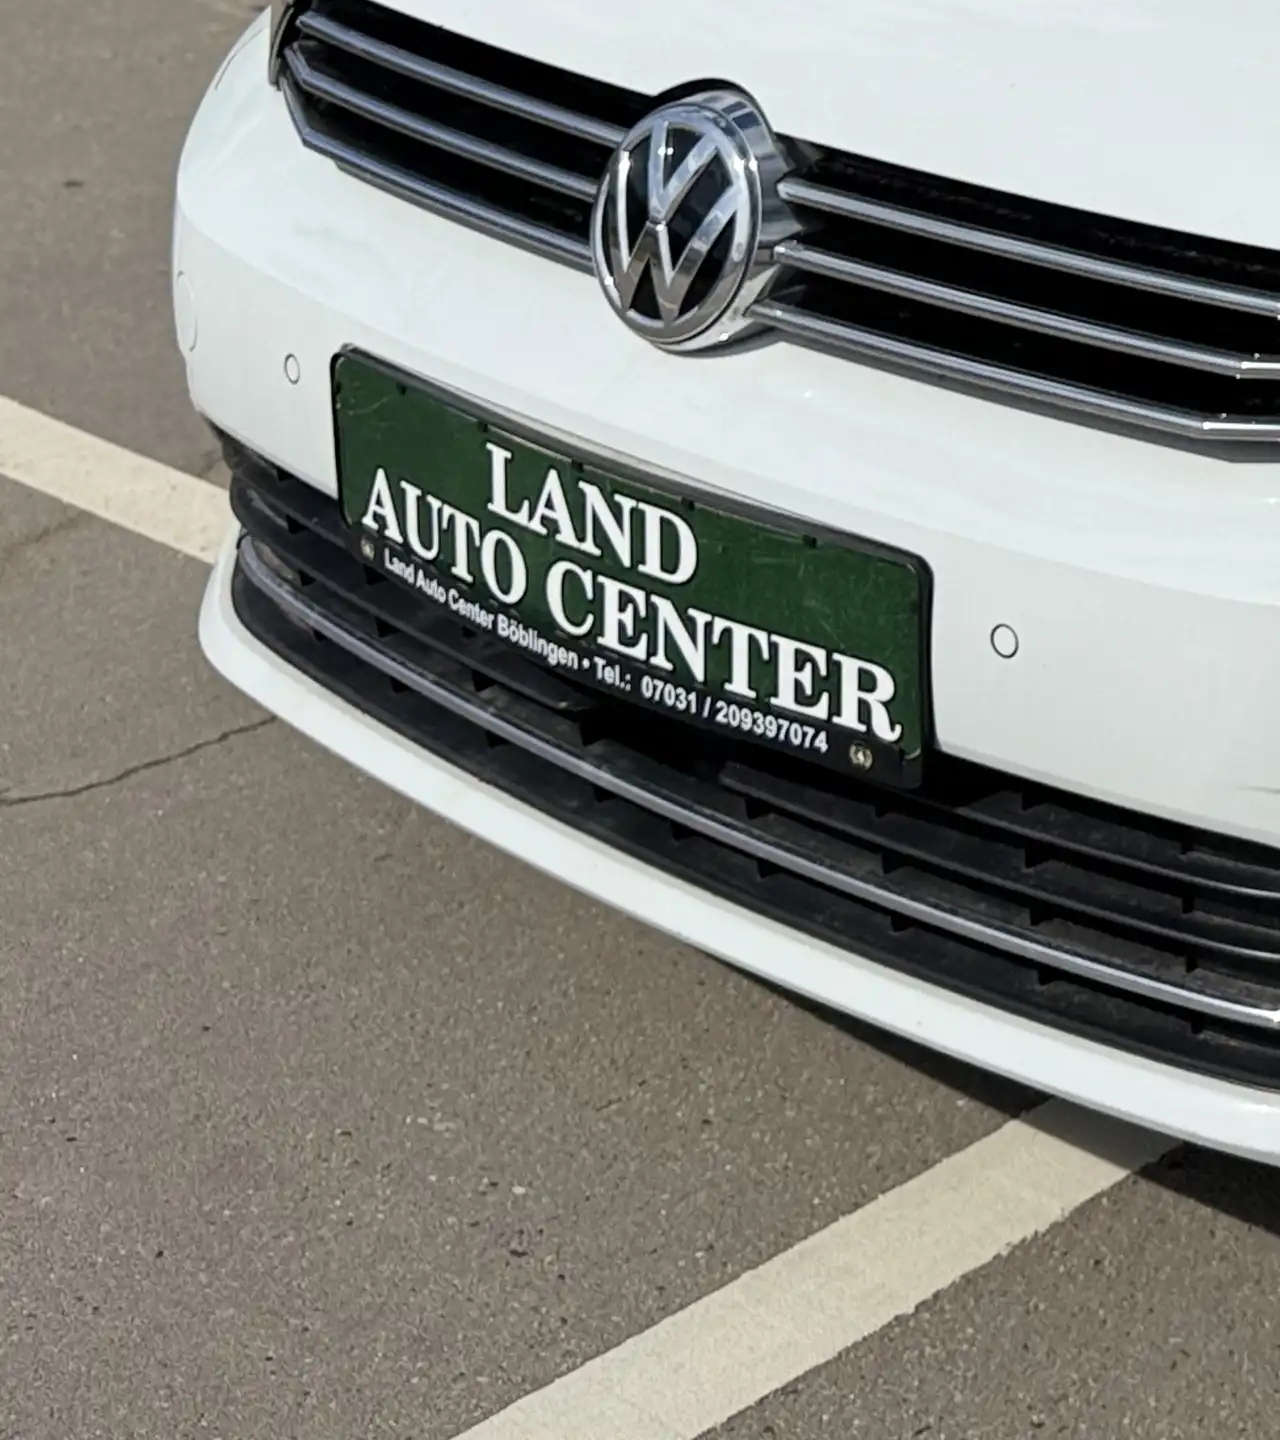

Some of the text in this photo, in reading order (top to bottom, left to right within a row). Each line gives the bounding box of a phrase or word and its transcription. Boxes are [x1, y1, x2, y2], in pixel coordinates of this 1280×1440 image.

[598, 108, 759, 340] VW
[362, 468, 903, 742] AUTO CENTER
[485, 442, 698, 585] LAND
[384, 547, 415, 585] Land
[415, 568, 447, 604] Auto
[448, 588, 495, 631] Center
[497, 612, 579, 670] Böblingen
[594, 656, 632, 692] Tel.:
[640, 675, 698, 715] 07031
[715, 701, 830, 755] 209397074
